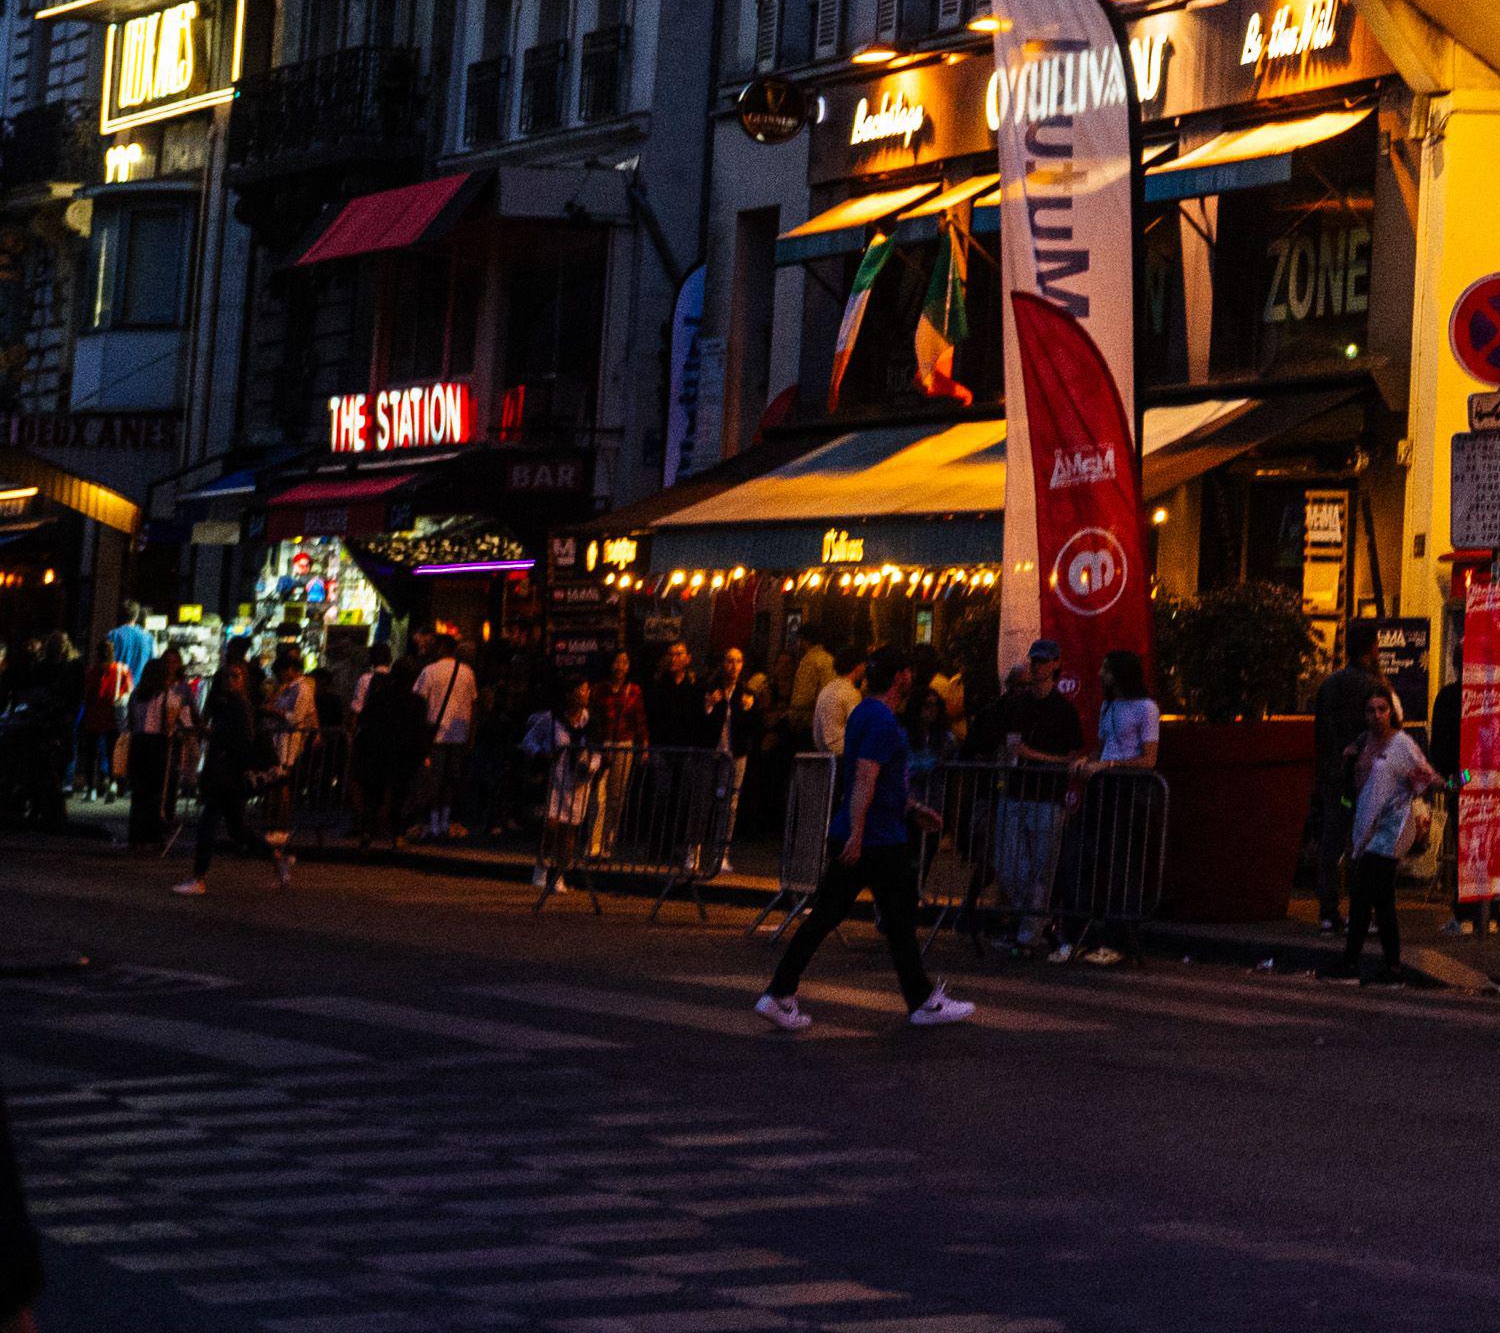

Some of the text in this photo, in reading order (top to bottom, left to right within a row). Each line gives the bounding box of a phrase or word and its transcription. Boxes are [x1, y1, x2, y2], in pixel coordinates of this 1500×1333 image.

[1264, 226, 1371, 324] ZONE
[327, 394, 367, 454] THE
[375, 381, 463, 448] STATION
[511, 462, 577, 490] BAR
